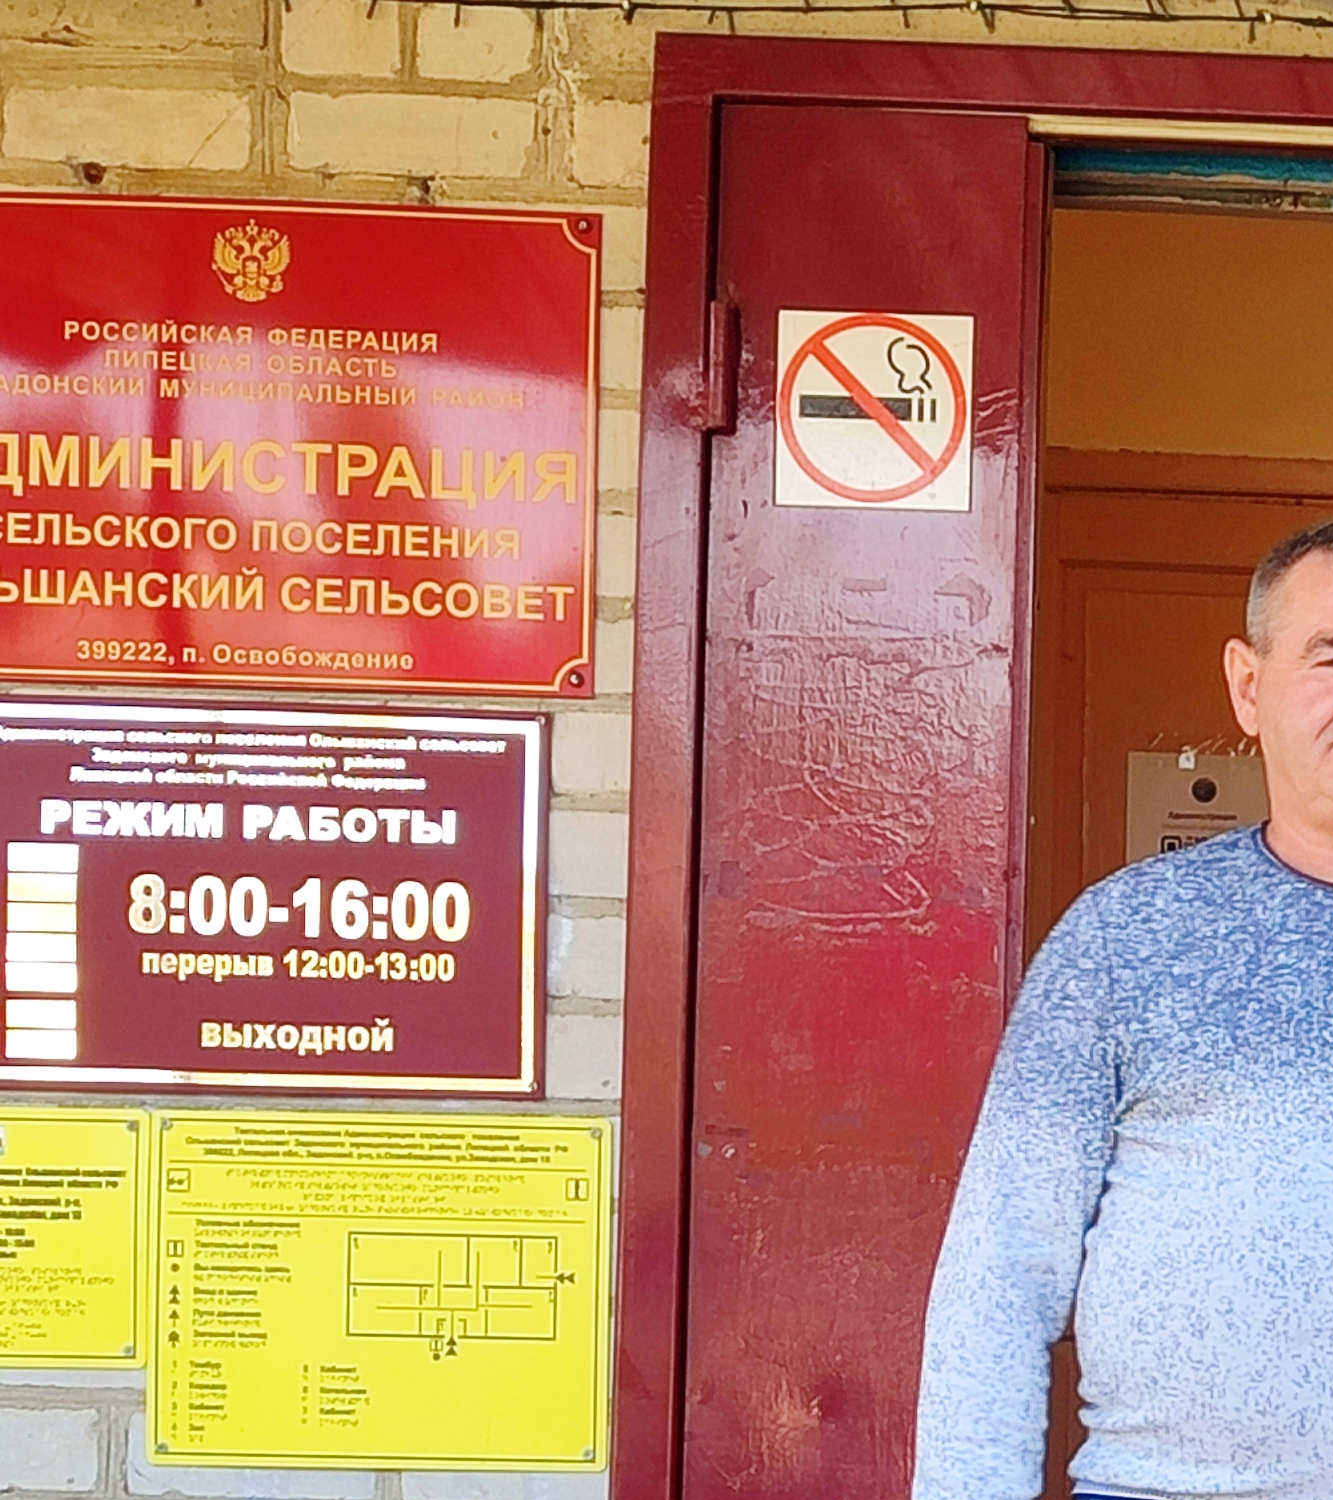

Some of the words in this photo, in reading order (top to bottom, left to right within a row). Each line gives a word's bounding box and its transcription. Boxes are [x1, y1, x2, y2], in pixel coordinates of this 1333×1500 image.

[63, 319, 254, 344] РОССИЙСКАЯ
[267, 327, 439, 354] ФЕДЕРАЦИЯ
[103, 349, 253, 373] ЛИПЕЦКАЯ
[267, 354, 398, 378] ОБЛАСТЬ
[0, 512, 238, 552] ЕЛЬСКОГО
[251, 518, 521, 560] ПОСЕЛЕНИЯ
[279, 576, 576, 622] СЕЛЬСОВЕТ
[76, 640, 176, 665] 399222,
[182, 648, 207, 664] п.
[213, 644, 414, 671] Освобождение
[39, 799, 224, 839] РЕЖИМ
[242, 804, 457, 845] РАБОТЫ
[128, 873, 471, 943] 8:00-16:00
[141, 950, 274, 982] перерыв
[283, 949, 455, 982] 12:00-13:00
